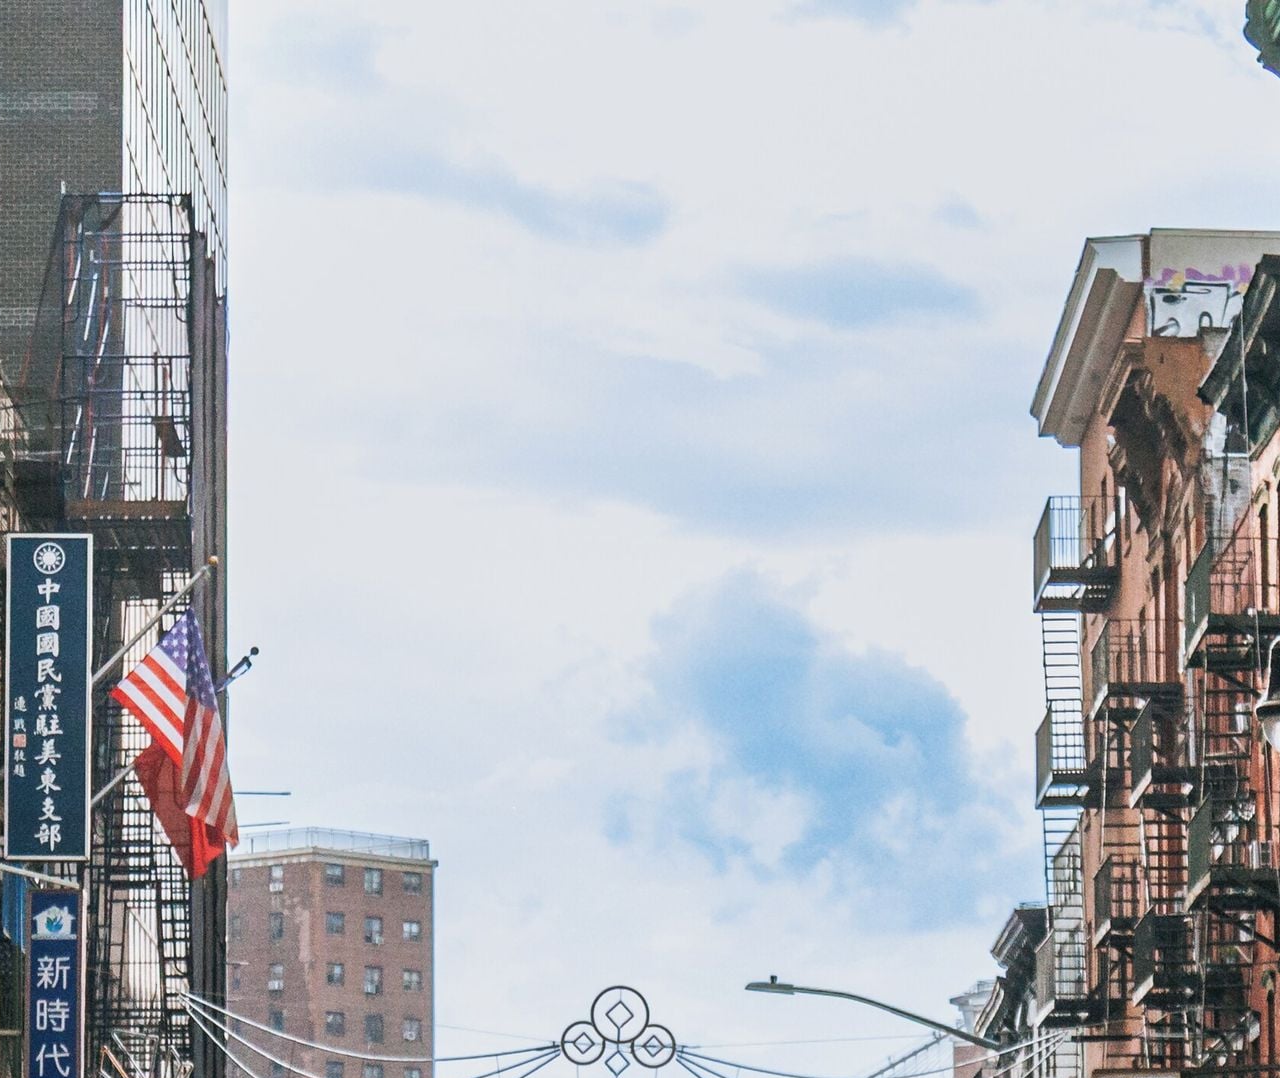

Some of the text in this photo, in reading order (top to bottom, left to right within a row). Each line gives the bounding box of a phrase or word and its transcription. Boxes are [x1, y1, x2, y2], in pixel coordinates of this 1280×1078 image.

[33, 578, 64, 852] 中國國民黨駐美東支部
